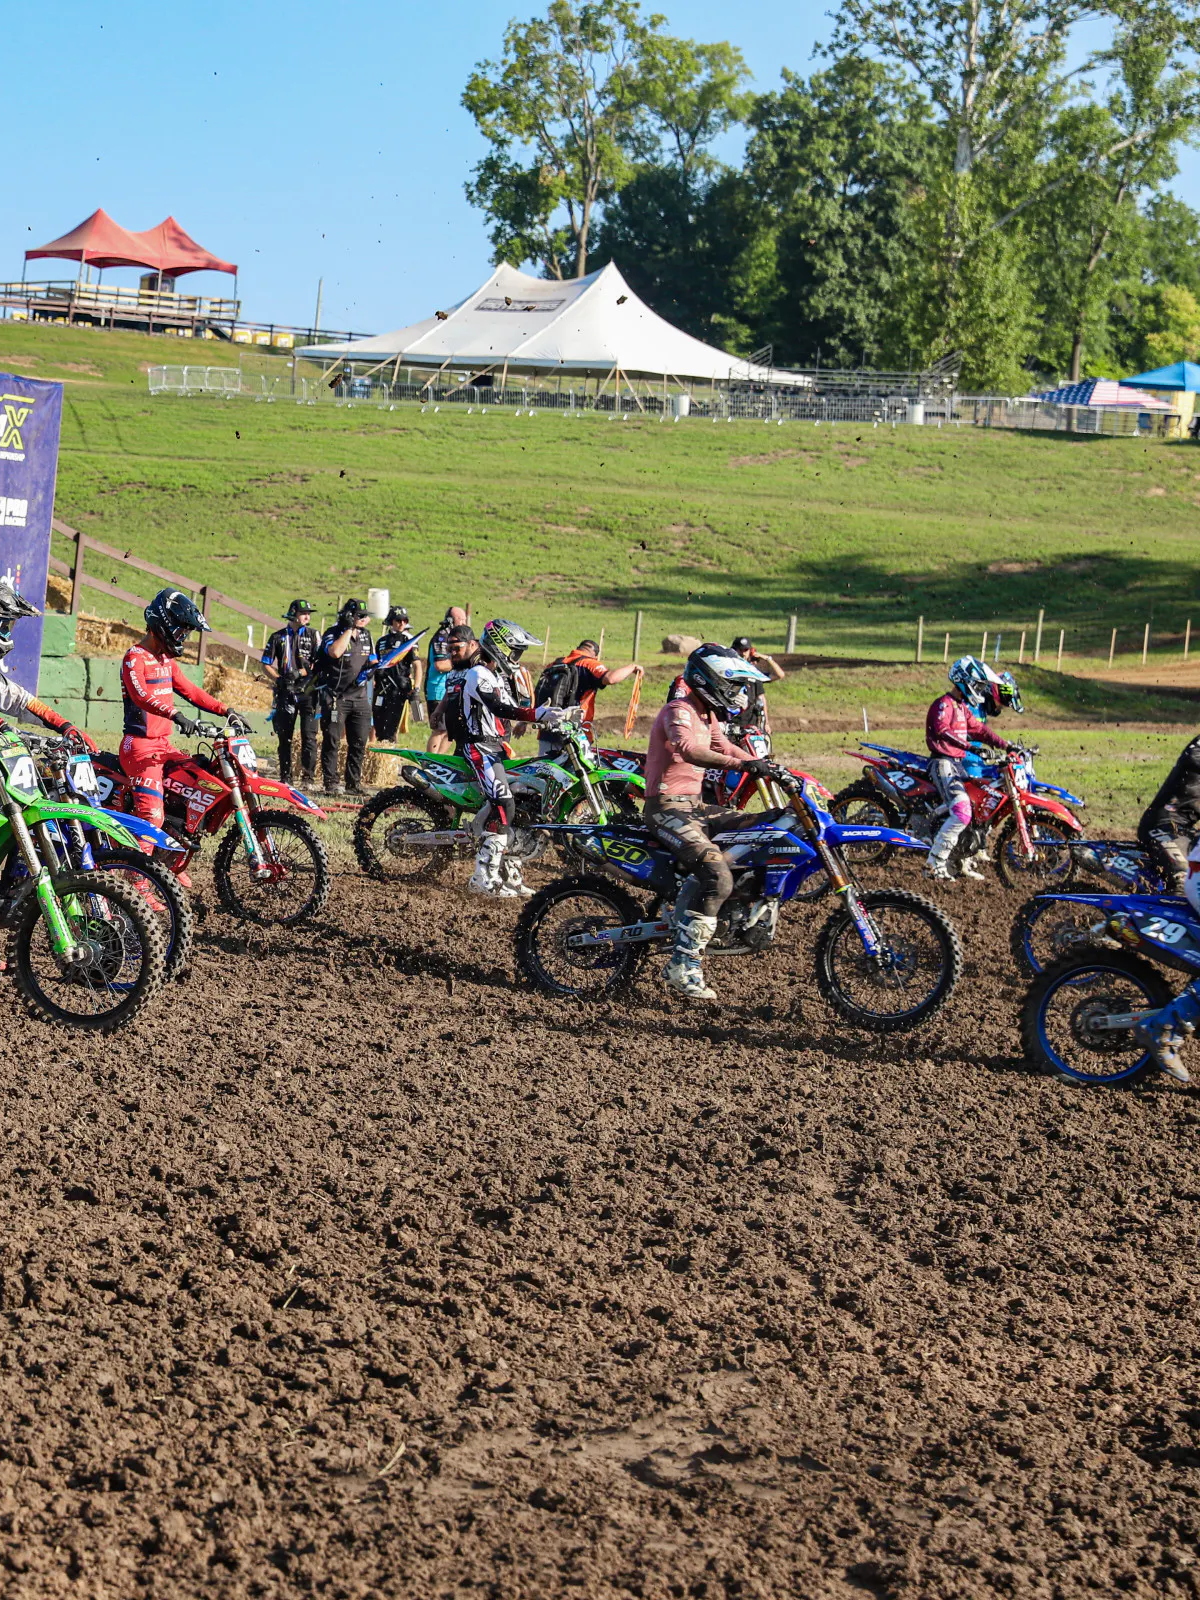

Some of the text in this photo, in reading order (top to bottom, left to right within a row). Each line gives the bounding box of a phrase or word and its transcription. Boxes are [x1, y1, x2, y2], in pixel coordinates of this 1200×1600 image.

[6, 499, 28, 517] PRO
[130, 671, 147, 698] GASGAS
[612, 757, 639, 772] 20
[886, 770, 916, 790] 43
[1140, 916, 1188, 943] 29
